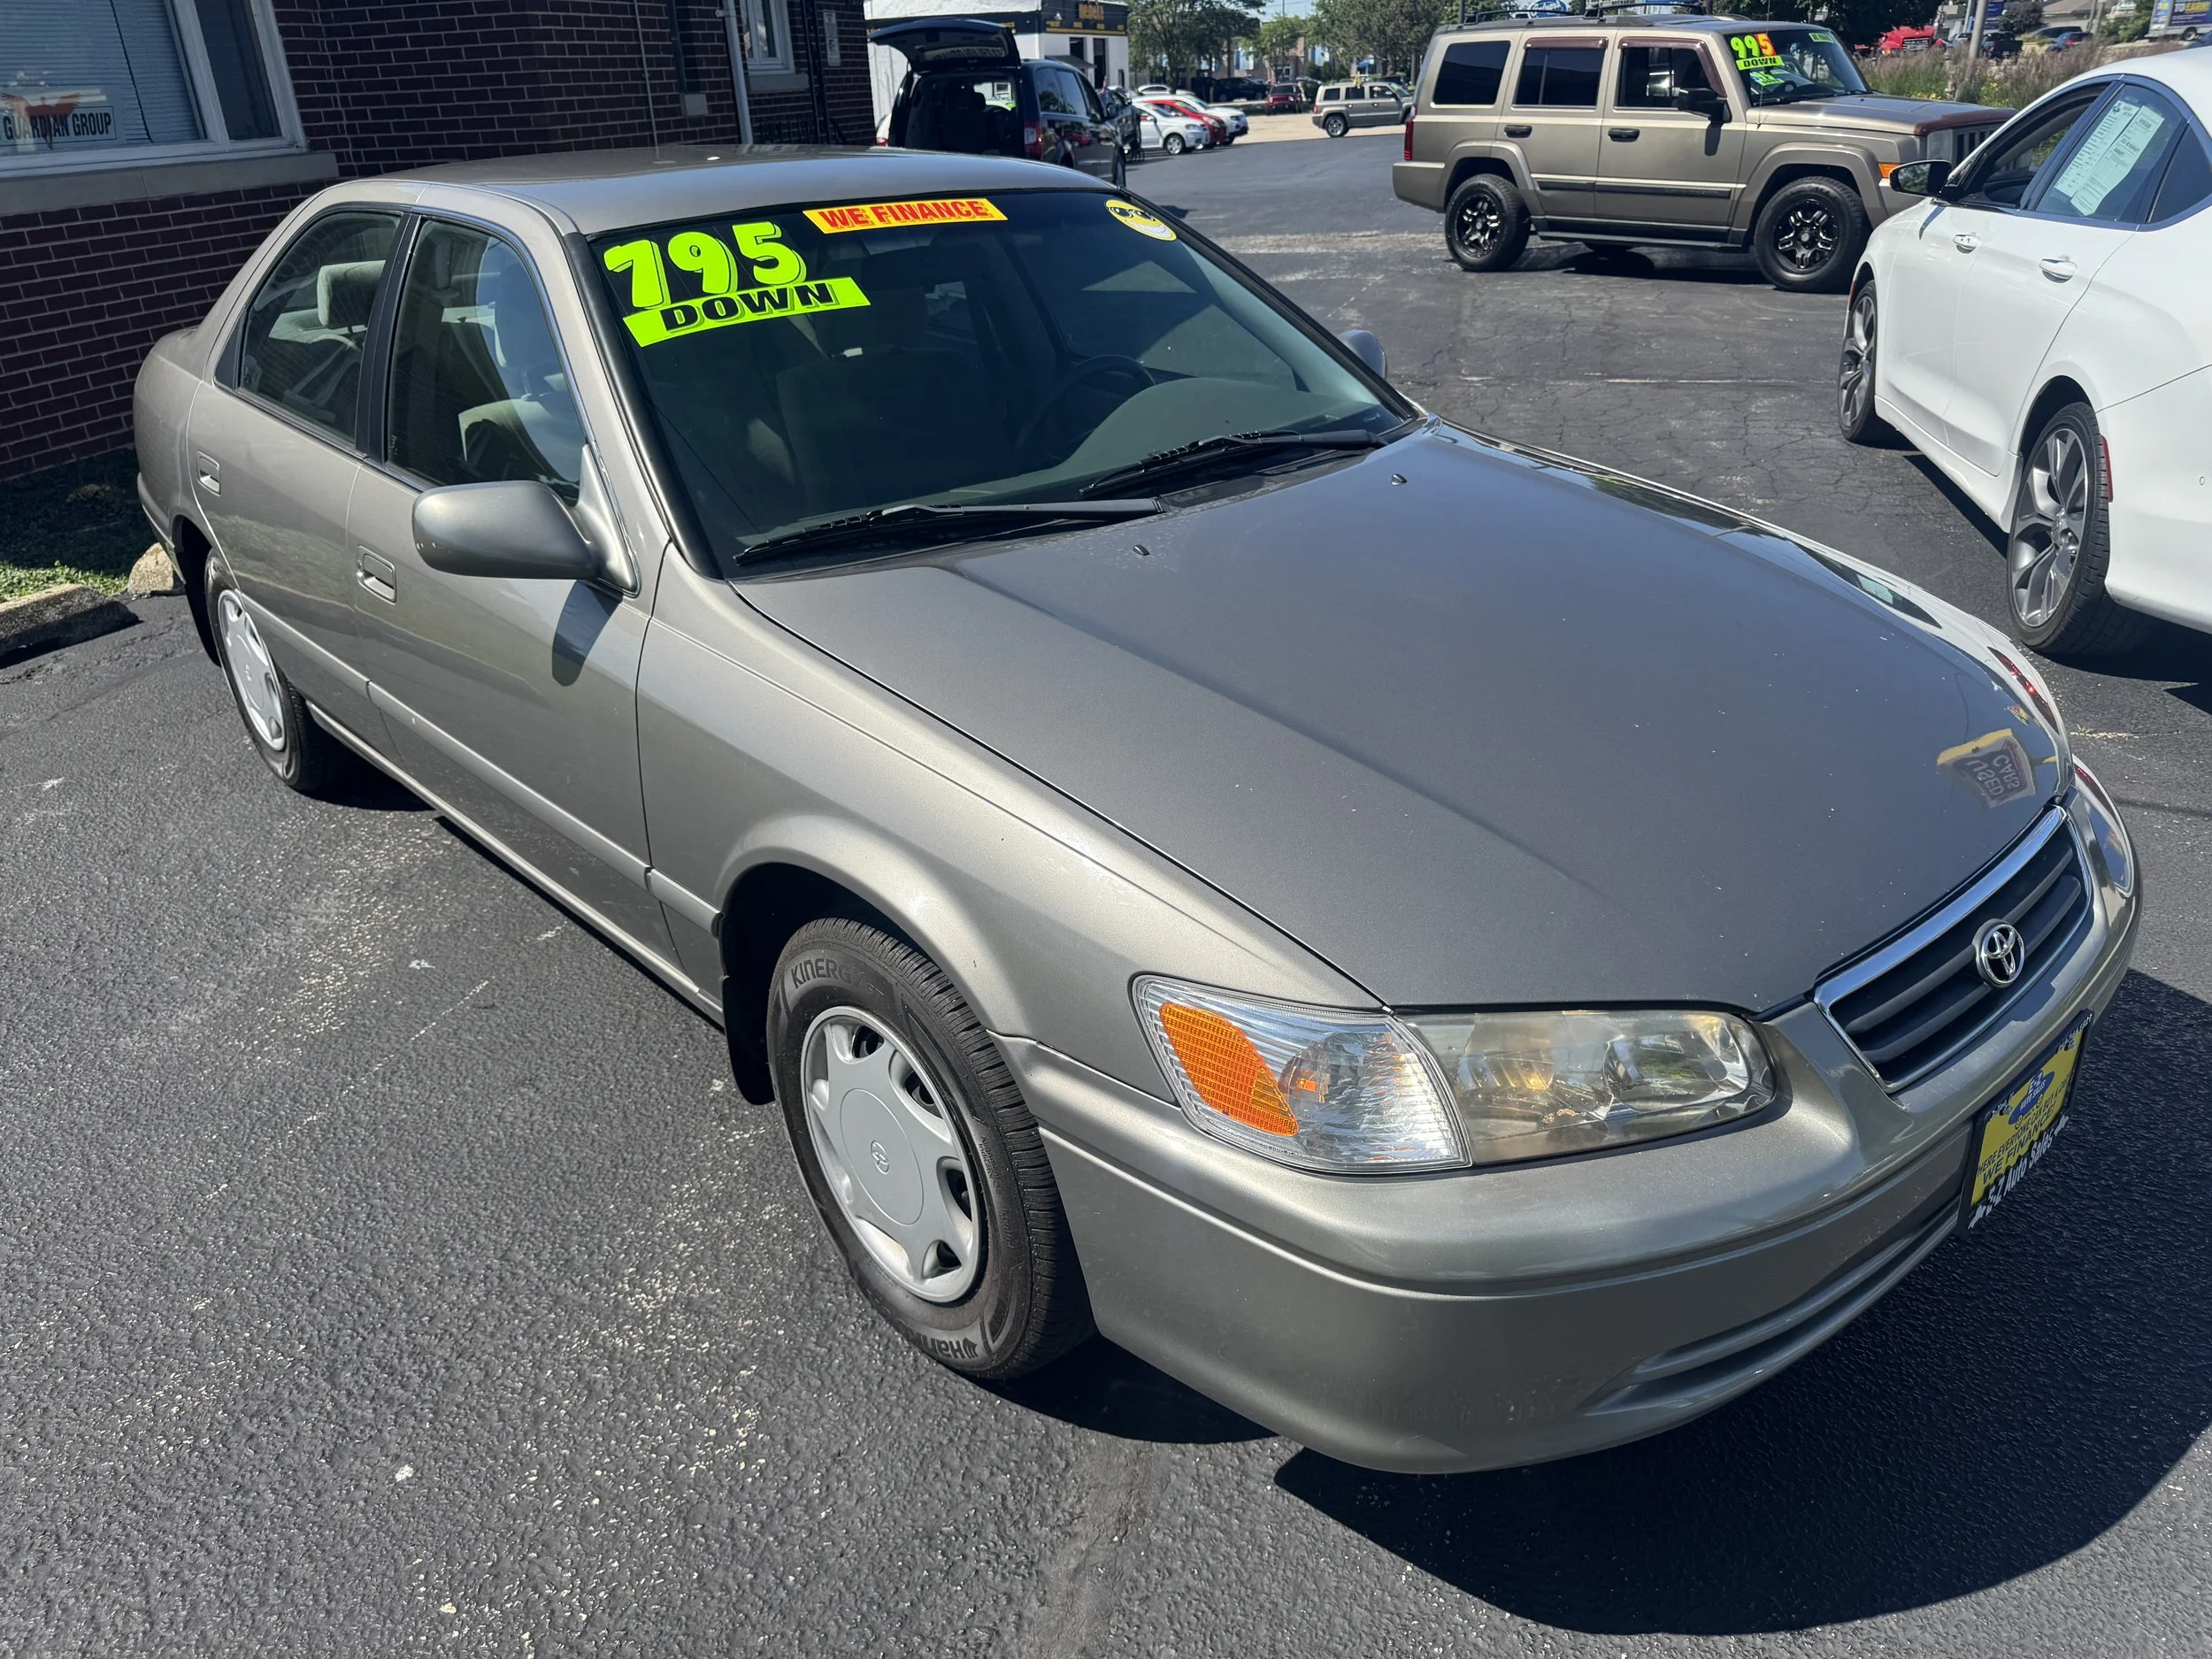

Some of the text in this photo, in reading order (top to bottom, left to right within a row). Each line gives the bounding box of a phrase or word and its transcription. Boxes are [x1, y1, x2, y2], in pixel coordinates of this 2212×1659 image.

[1730, 34, 1775, 59] 995
[1743, 58, 1777, 68] DOWN
[3, 111, 111, 141] GUARDIAN GROUP
[818, 201, 995, 228] WE FINANCE
[603, 221, 807, 310] 795
[659, 283, 840, 334] DOWN
[790, 957, 869, 989] KINERGY
[1982, 1156, 2004, 1185] WE
[1985, 1128, 2054, 1217] E-Z Auto Sales
